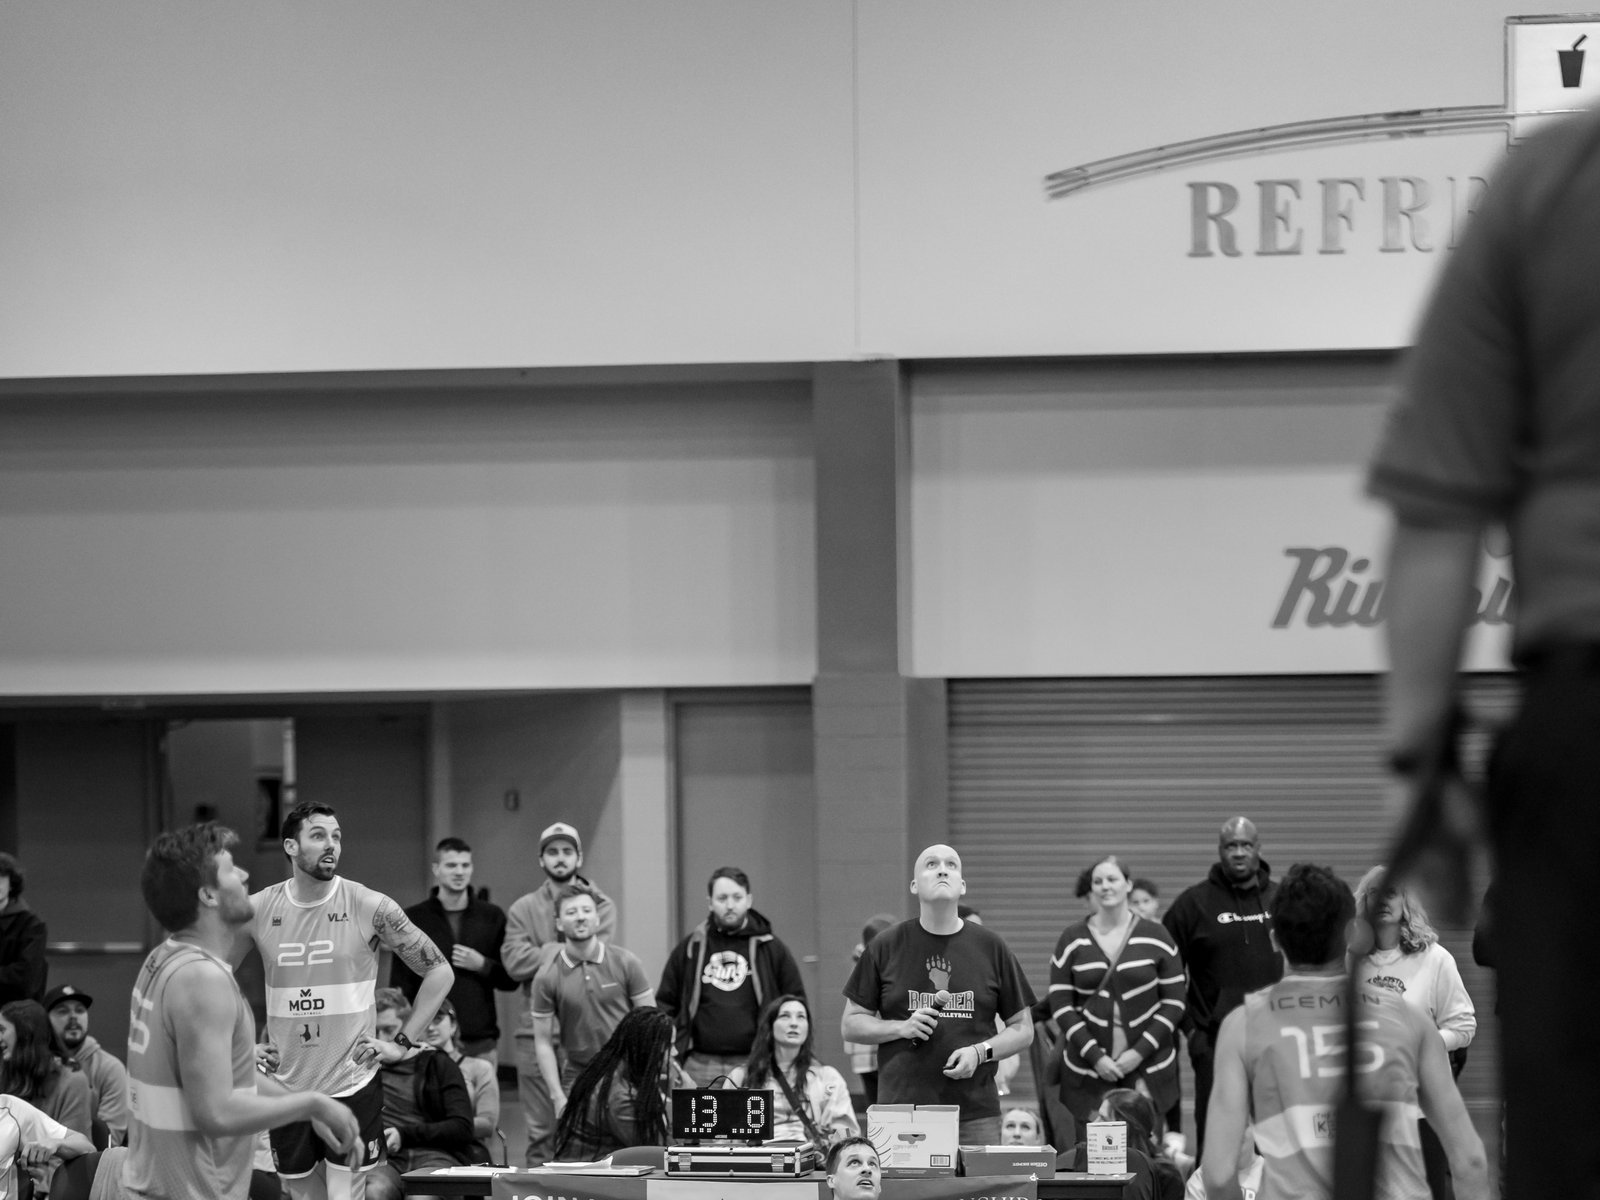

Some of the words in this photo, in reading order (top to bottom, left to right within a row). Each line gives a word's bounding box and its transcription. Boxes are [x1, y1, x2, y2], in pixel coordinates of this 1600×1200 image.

[327, 912, 349, 922] VLA
[277, 939, 334, 967] 22
[289, 998, 325, 1012] MOD
[1269, 993, 1380, 1012] ICEMN
[1280, 1020, 1385, 1079] 15
[691, 1095, 718, 1128] 13
[746, 1096, 765, 1129] 8
